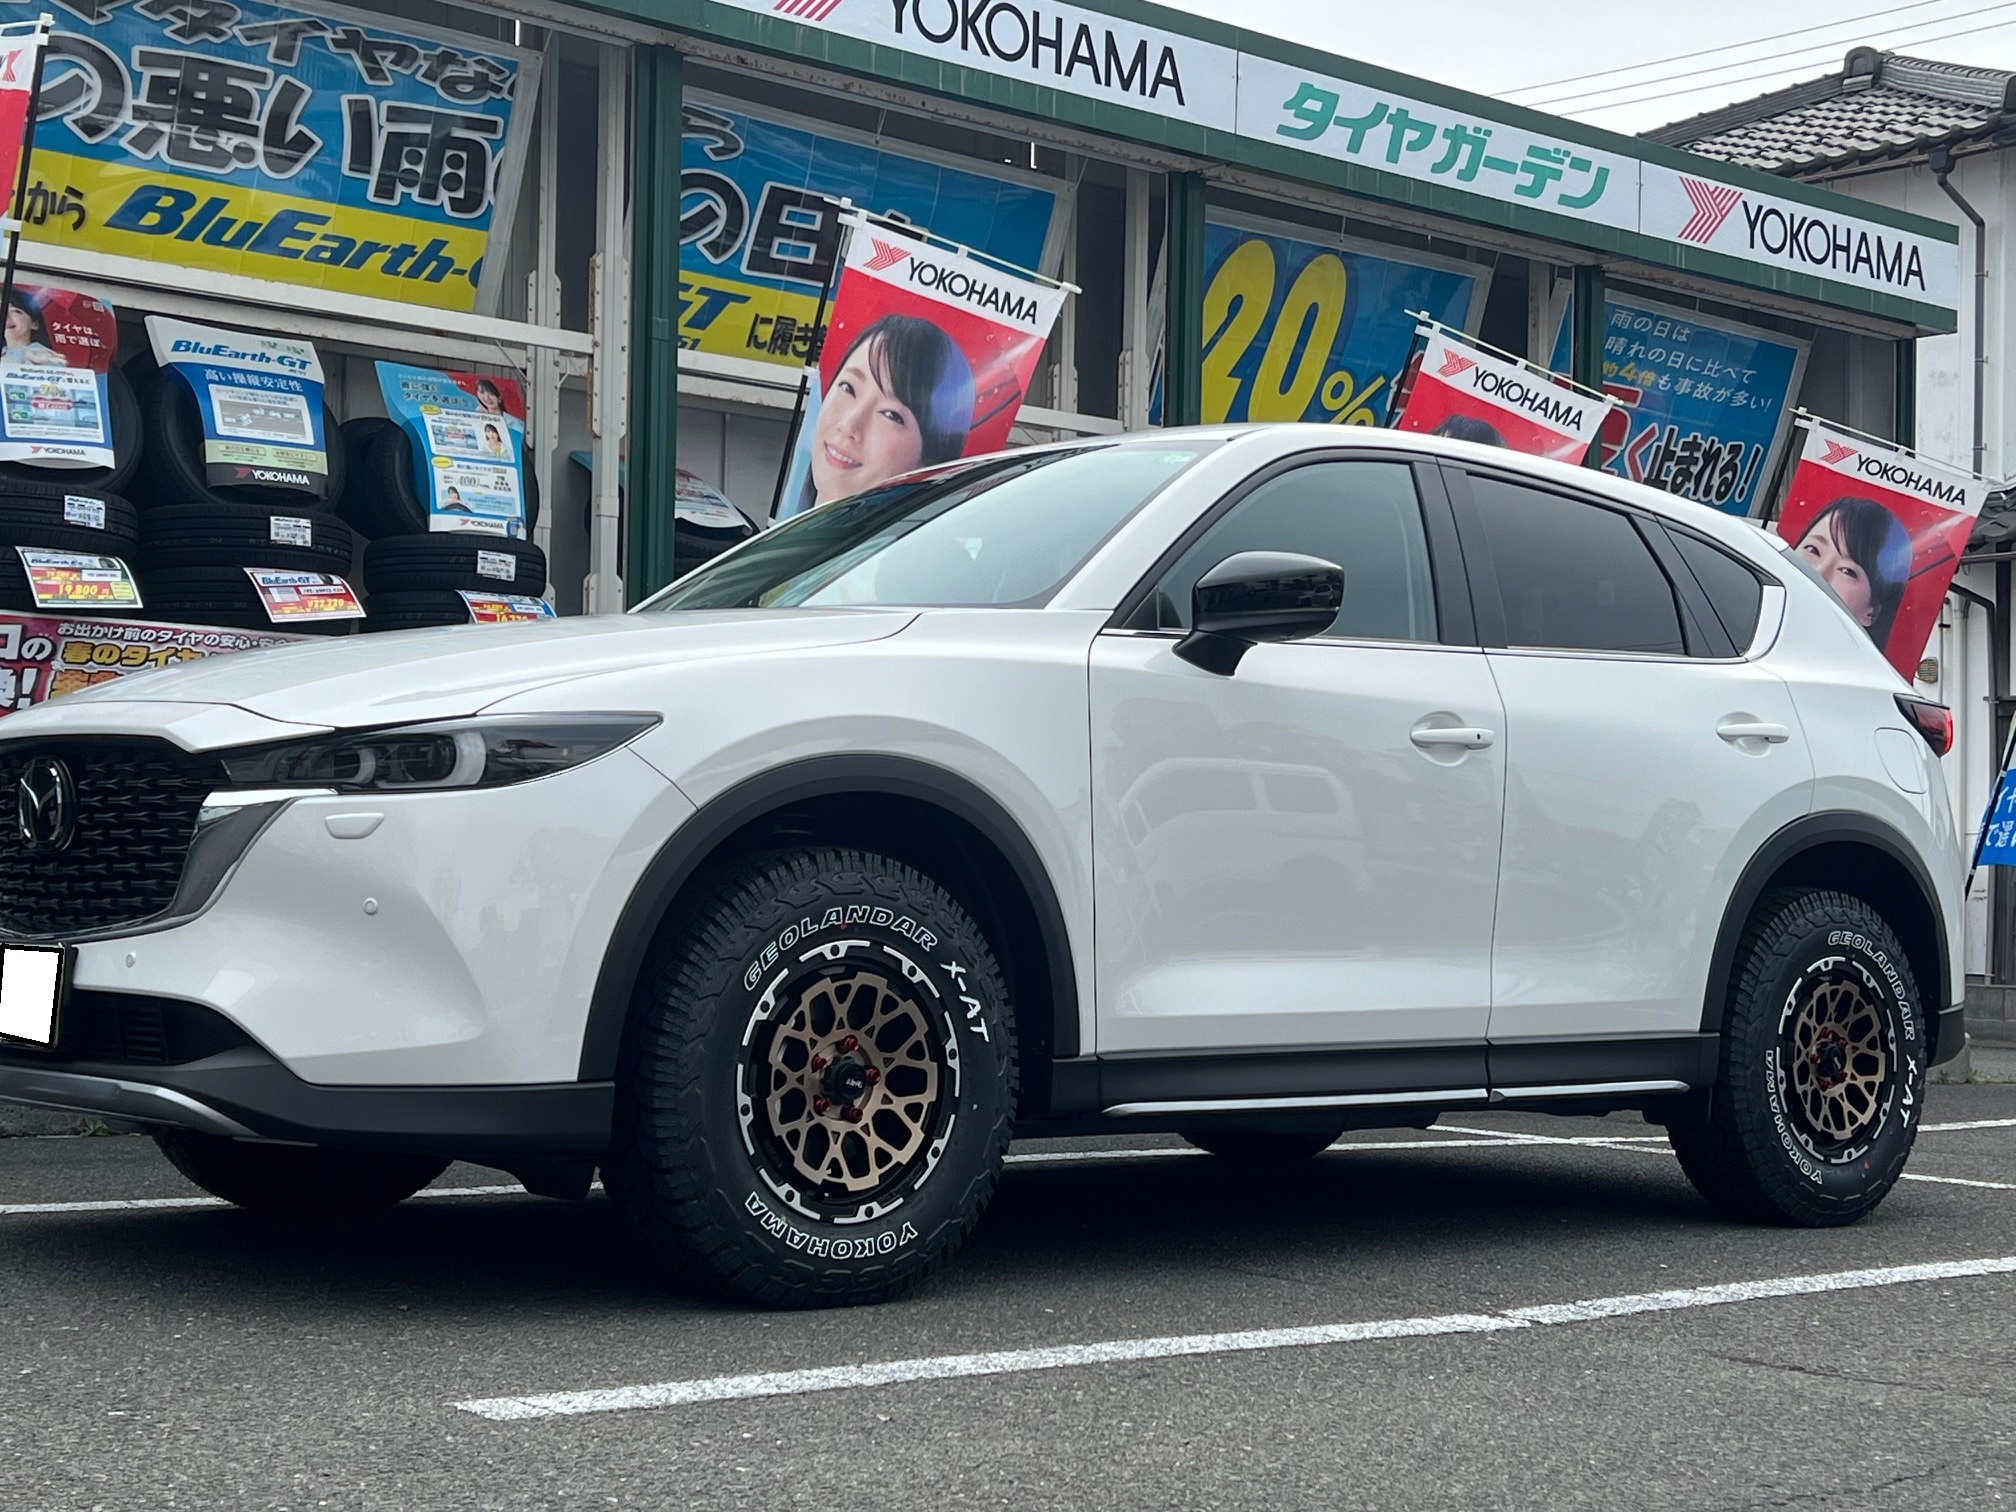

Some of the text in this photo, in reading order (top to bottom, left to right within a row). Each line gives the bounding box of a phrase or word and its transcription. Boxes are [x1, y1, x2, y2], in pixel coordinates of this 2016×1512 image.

[55, 0, 516, 100] タイヤな
[892, 0, 1186, 106] YOKOHAMA
[38, 34, 507, 218] の悪い雨
[1276, 82, 1609, 210] タイヤガーデン
[24, 181, 487, 284] から BluEarth-
[1742, 199, 1926, 292] YOKOHAMA
[908, 256, 1037, 325] YOKOHAMA
[170, 339, 313, 371] BluEarth-GT
[1604, 335, 1758, 385] 晴れの日に比べて
[1610, 308, 1692, 343] 雨の日は
[1472, 366, 1583, 432] YOKOHAMA
[44, 446, 87, 456] YOKOHAMA
[252, 469, 311, 486] YOKOHAMA
[1856, 453, 1966, 507] YOKOHAMA
[470, 520, 504, 530] YOKOHAMA
[743, 904, 990, 1043] GEOLANDAR X-AT
[1827, 930, 1919, 1129] GEOLANDAR X-AT
[1764, 1049, 1824, 1185] YOKOHAMA
[744, 1191, 918, 1260] YOKOHAMA
